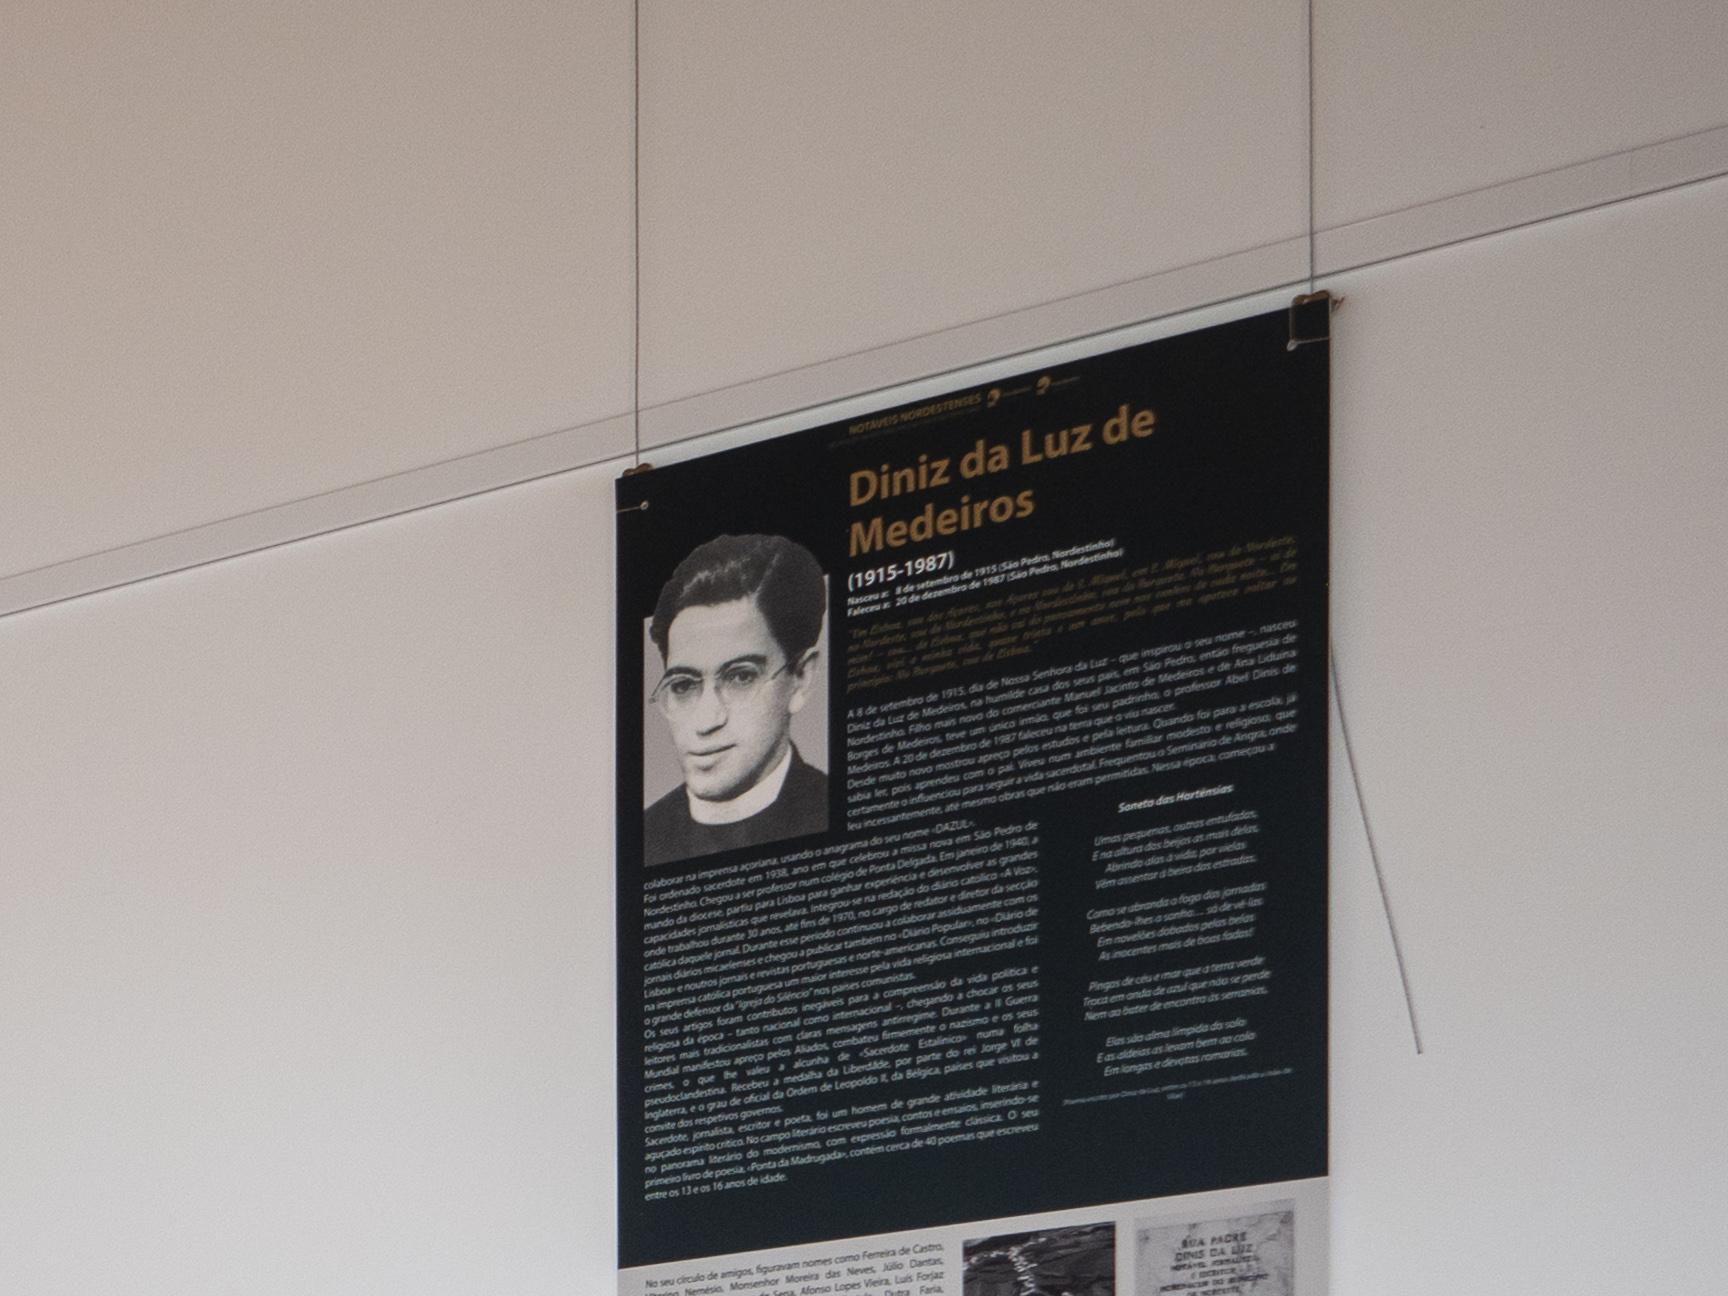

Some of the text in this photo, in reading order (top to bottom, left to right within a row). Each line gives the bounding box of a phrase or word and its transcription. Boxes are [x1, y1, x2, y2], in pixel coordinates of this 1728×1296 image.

[849, 403, 1154, 506] Diniz da Luz de
[849, 489, 1033, 557] Medeiros
[847, 550, 954, 591] (1915-1987)
[1118, 798, 1155, 813] Soneto
[1176, 784, 1233, 801] Hortênsias
[676, 1272, 705, 1285] círculo
[720, 1267, 754, 1279] amigos,
[755, 1261, 800, 1275] figuravam
[801, 1257, 833, 1268] nomes
[834, 1253, 860, 1264] como
[861, 1248, 896, 1260] Ferreira
[911, 1243, 944, 1254] Castro,
[684, 1285, 724, 1296] Nemésio,
[729, 1277, 780, 1290] Monsenhor
[784, 1272, 819, 1283] Moreira
[846, 1265, 876, 1276] Neves,
[909, 1257, 944, 1269] Dantas,
